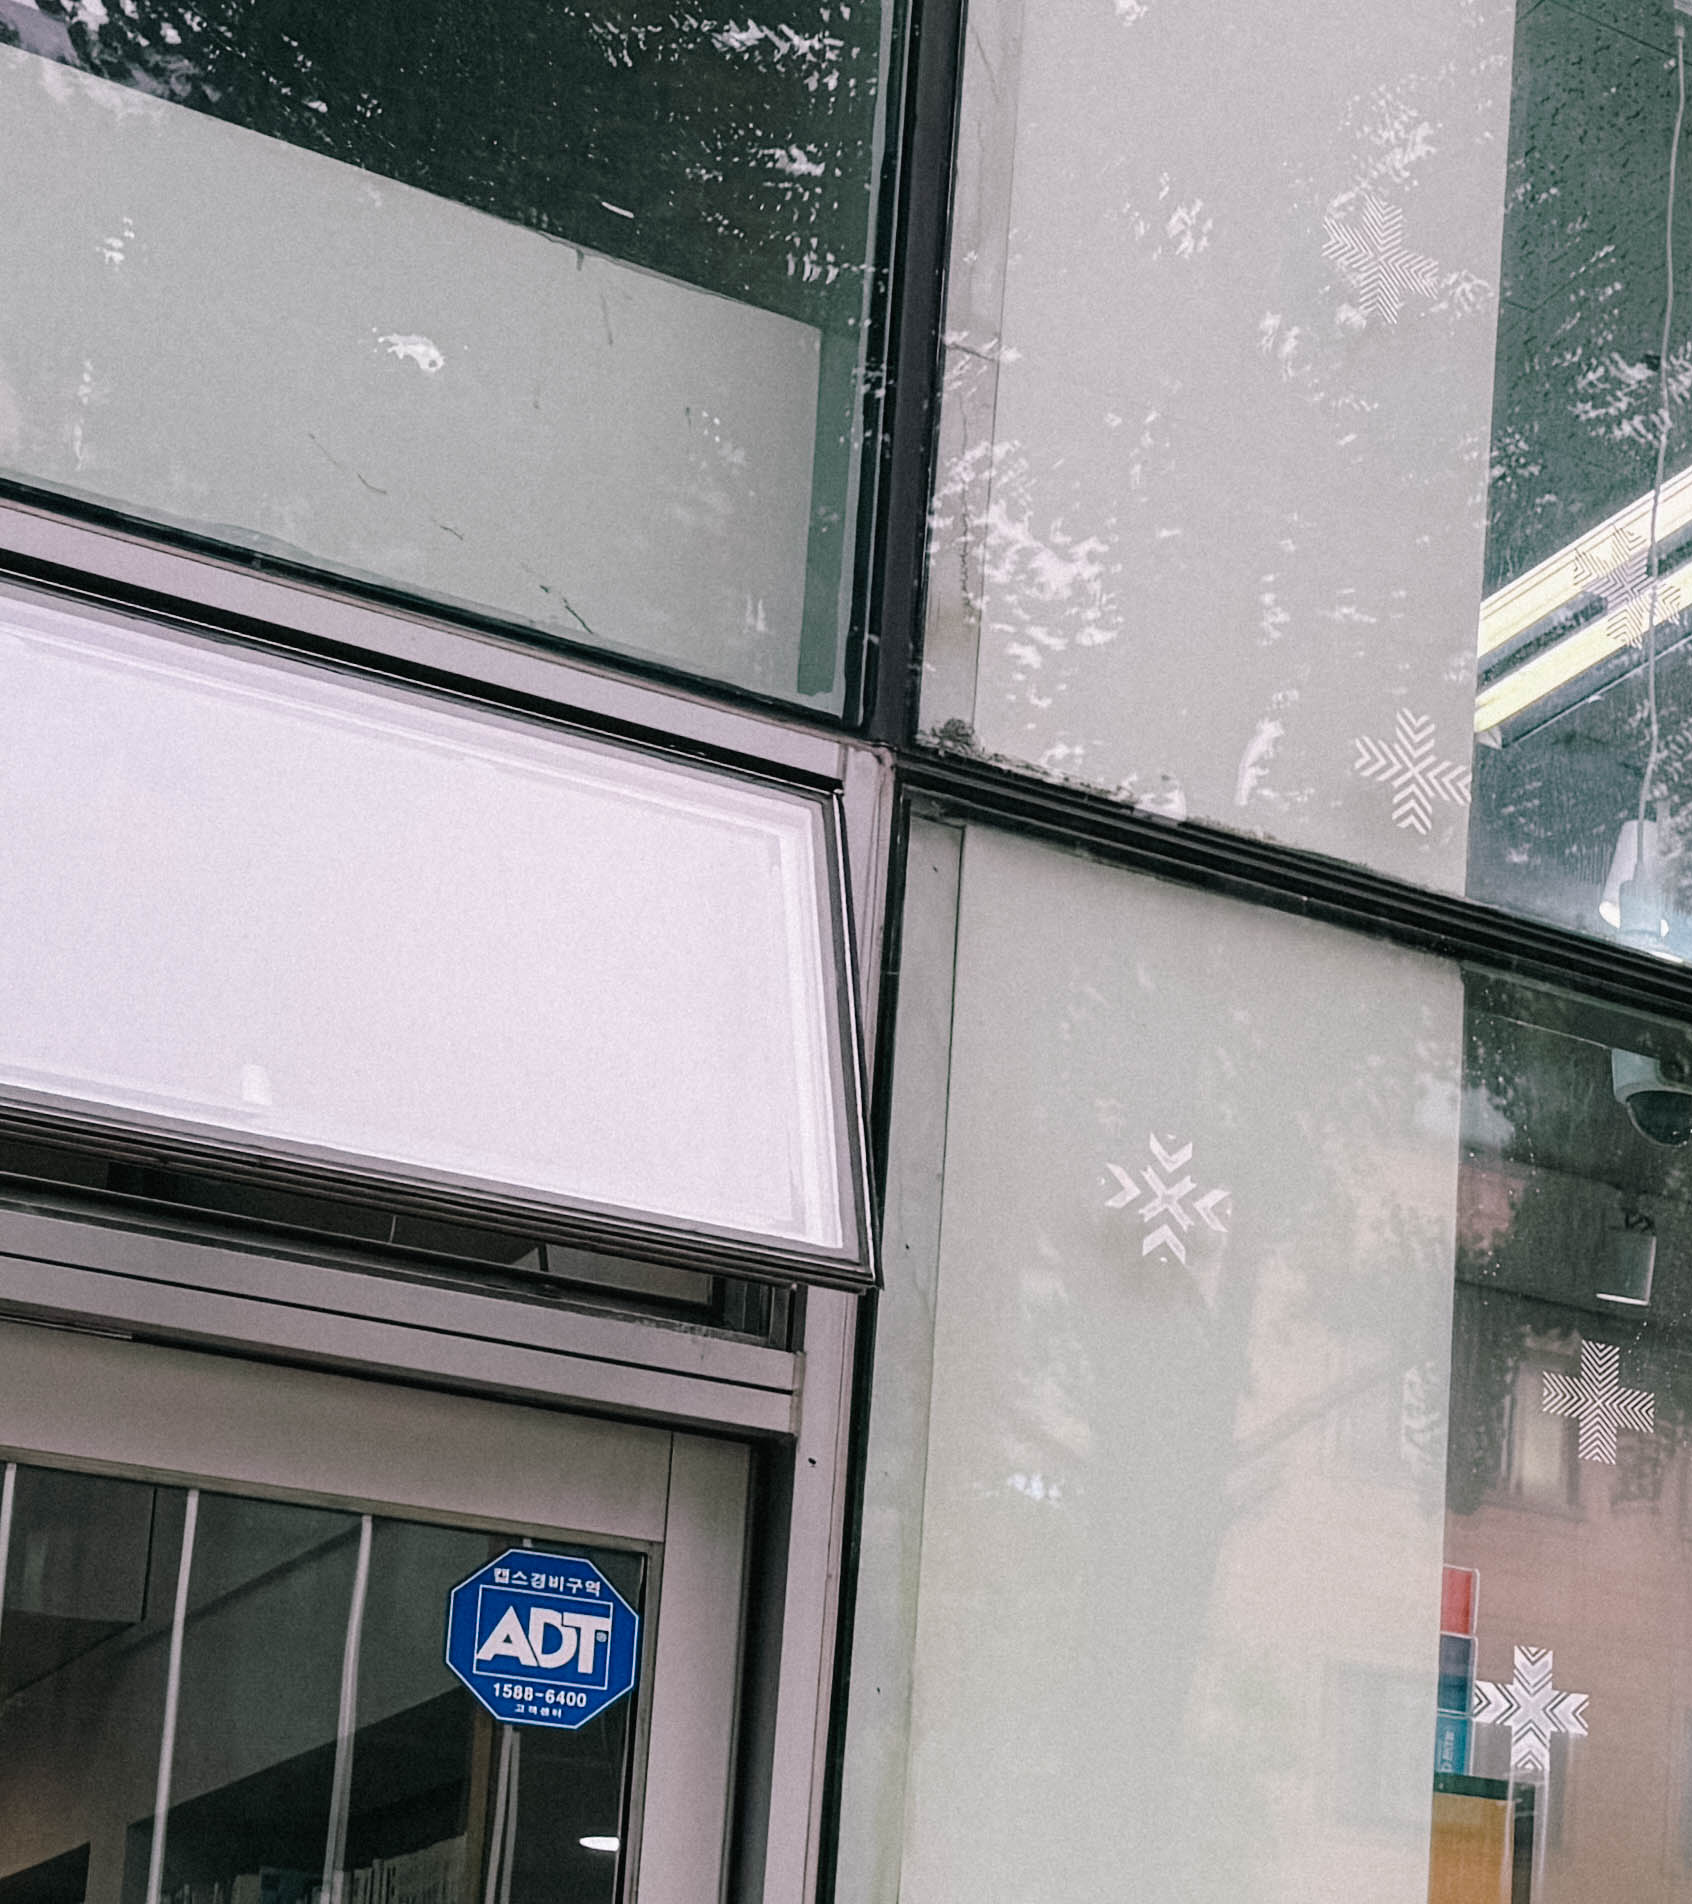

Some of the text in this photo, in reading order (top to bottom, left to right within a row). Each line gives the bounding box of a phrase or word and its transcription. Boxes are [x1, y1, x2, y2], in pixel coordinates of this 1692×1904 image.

[493, 1567, 602, 1597] 캡스경비구역
[475, 1604, 612, 1675] ADT
[492, 1683, 588, 1708] 1588-6400
